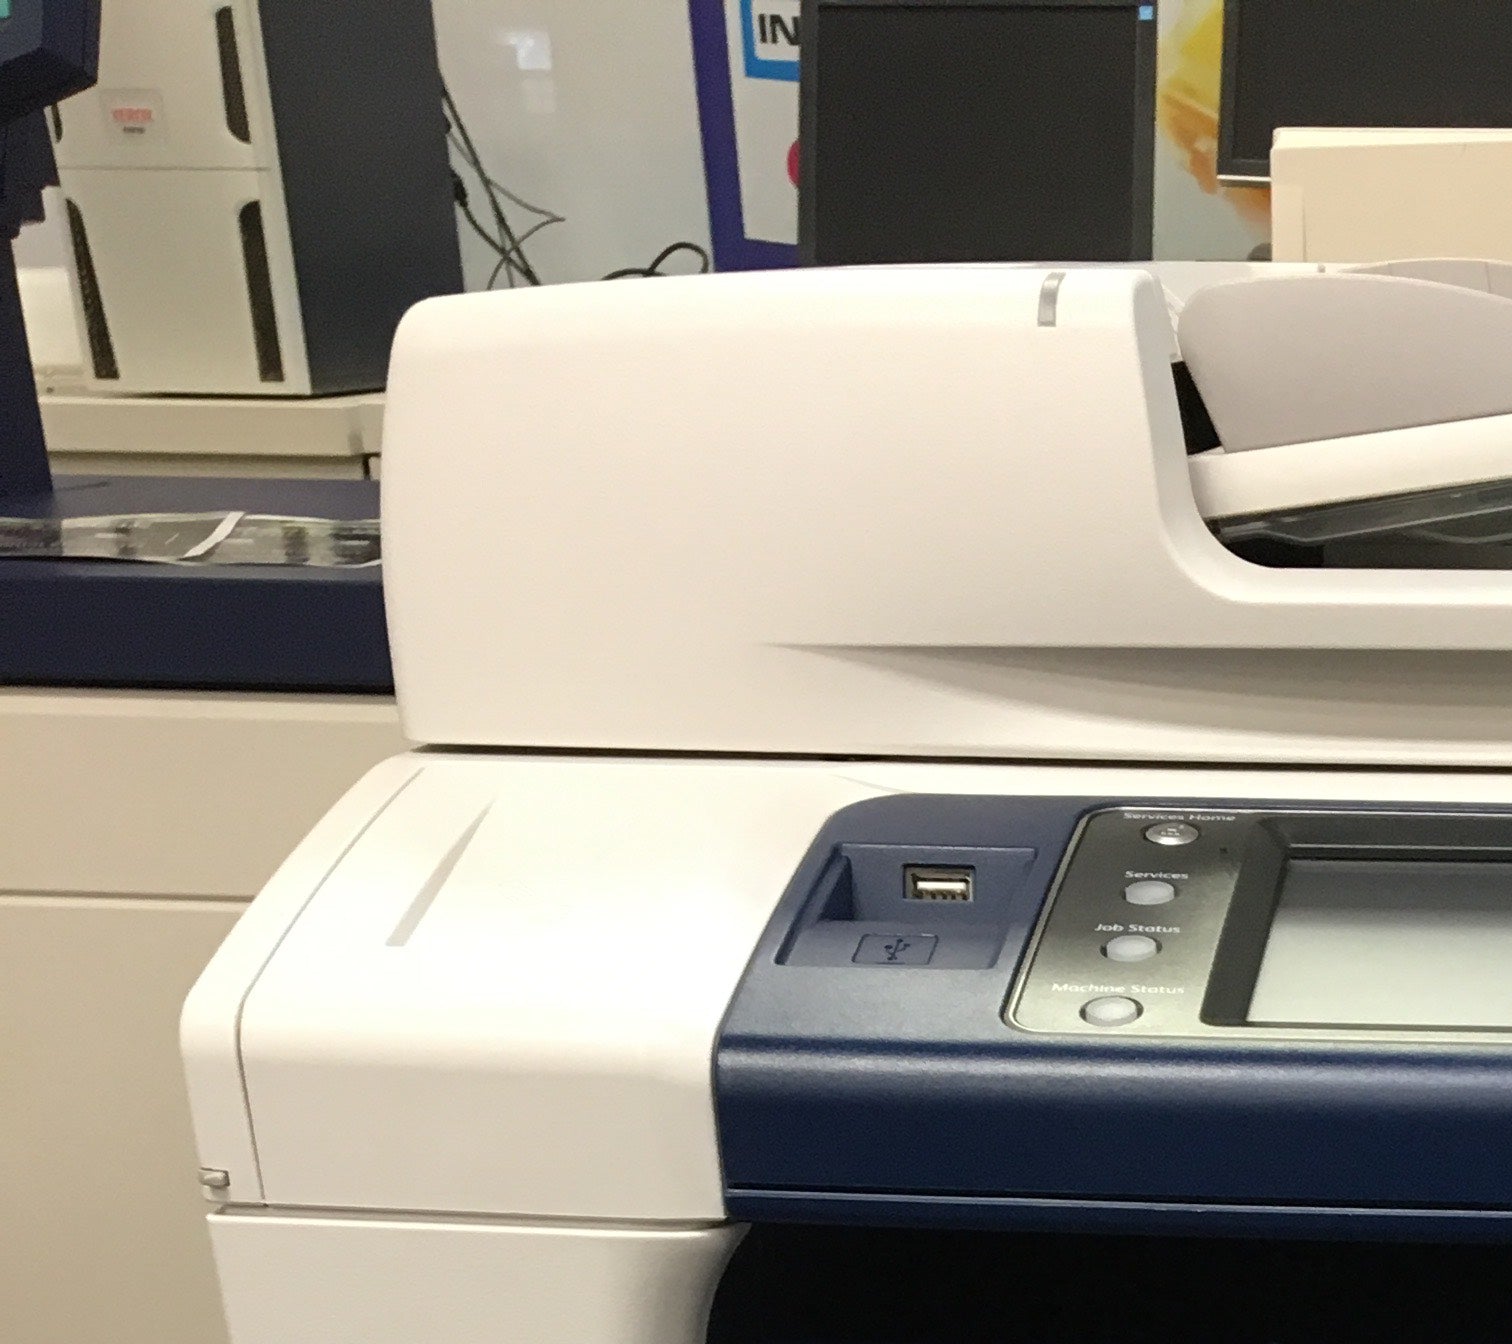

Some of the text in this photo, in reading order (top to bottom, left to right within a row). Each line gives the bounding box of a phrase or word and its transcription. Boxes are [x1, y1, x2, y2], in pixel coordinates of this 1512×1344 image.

[1125, 870, 1189, 880] Services
[1094, 923, 1181, 933] Job Status
[1051, 983, 1185, 994] Machine Status
